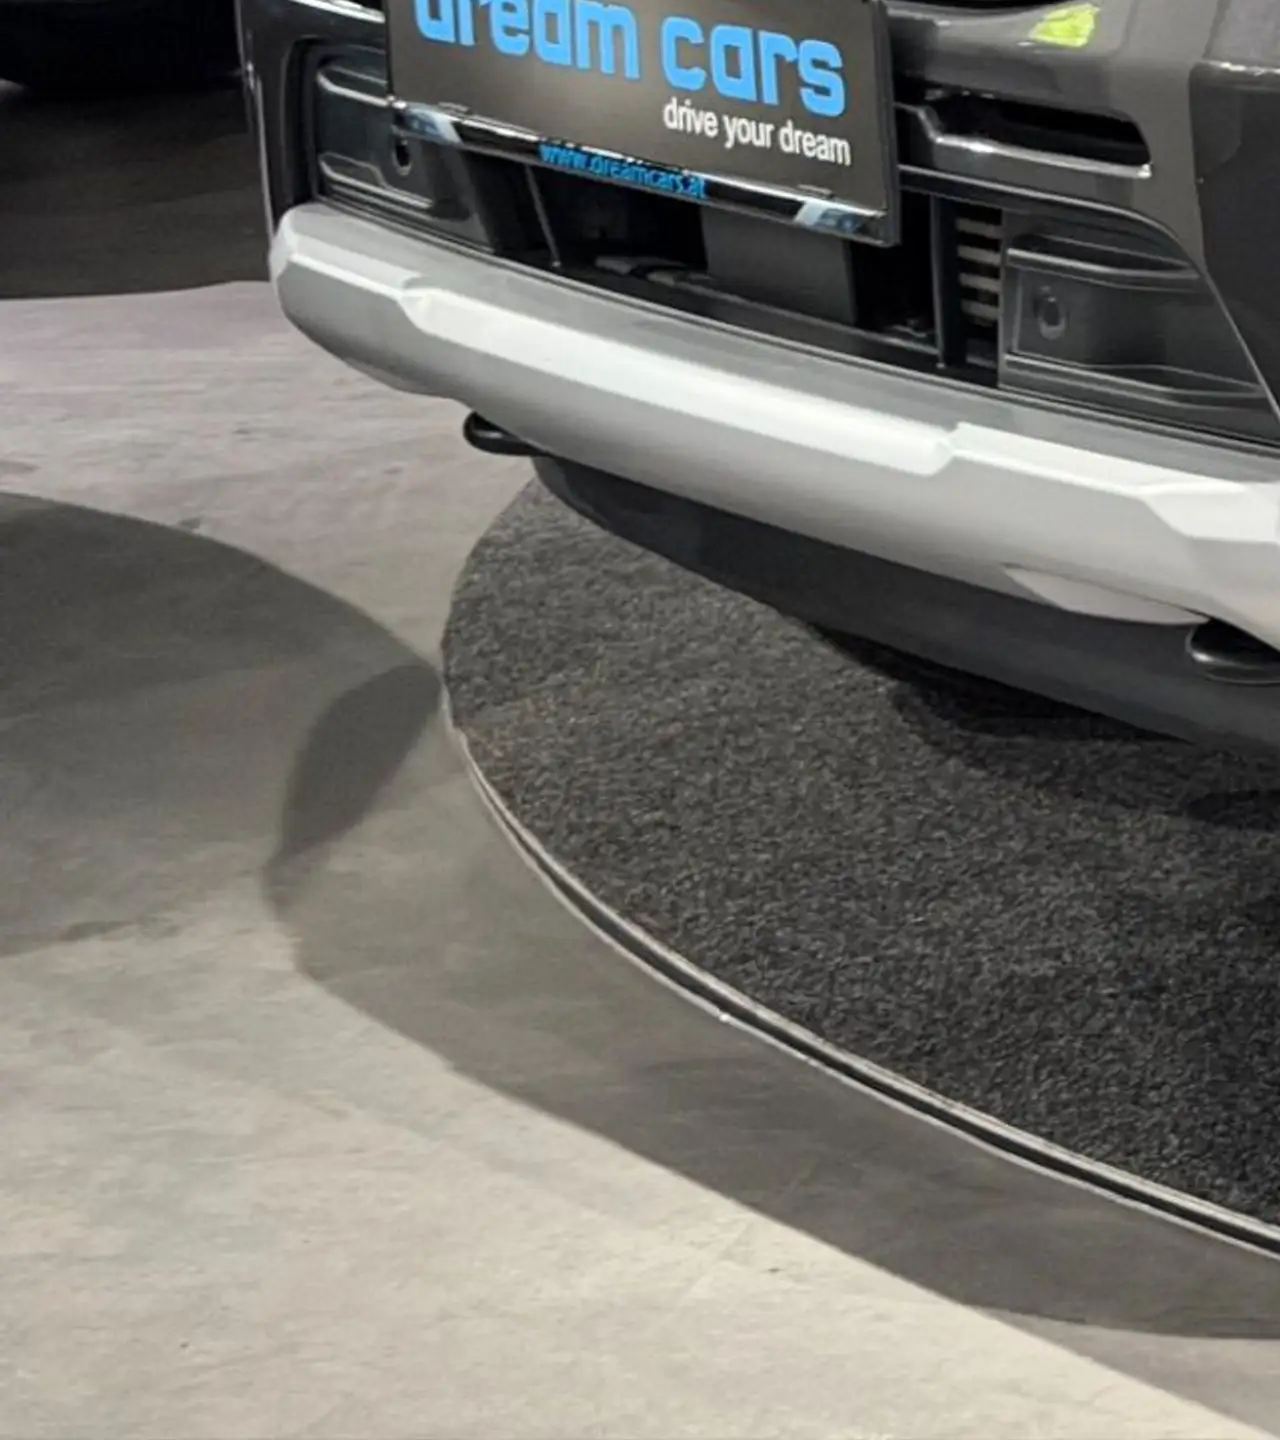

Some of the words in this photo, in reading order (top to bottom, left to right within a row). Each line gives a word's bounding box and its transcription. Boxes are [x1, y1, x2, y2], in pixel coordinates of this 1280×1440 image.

[661, 14, 847, 118] cars
[662, 96, 719, 140] drive
[722, 112, 775, 153] your
[778, 119, 851, 167] dream
